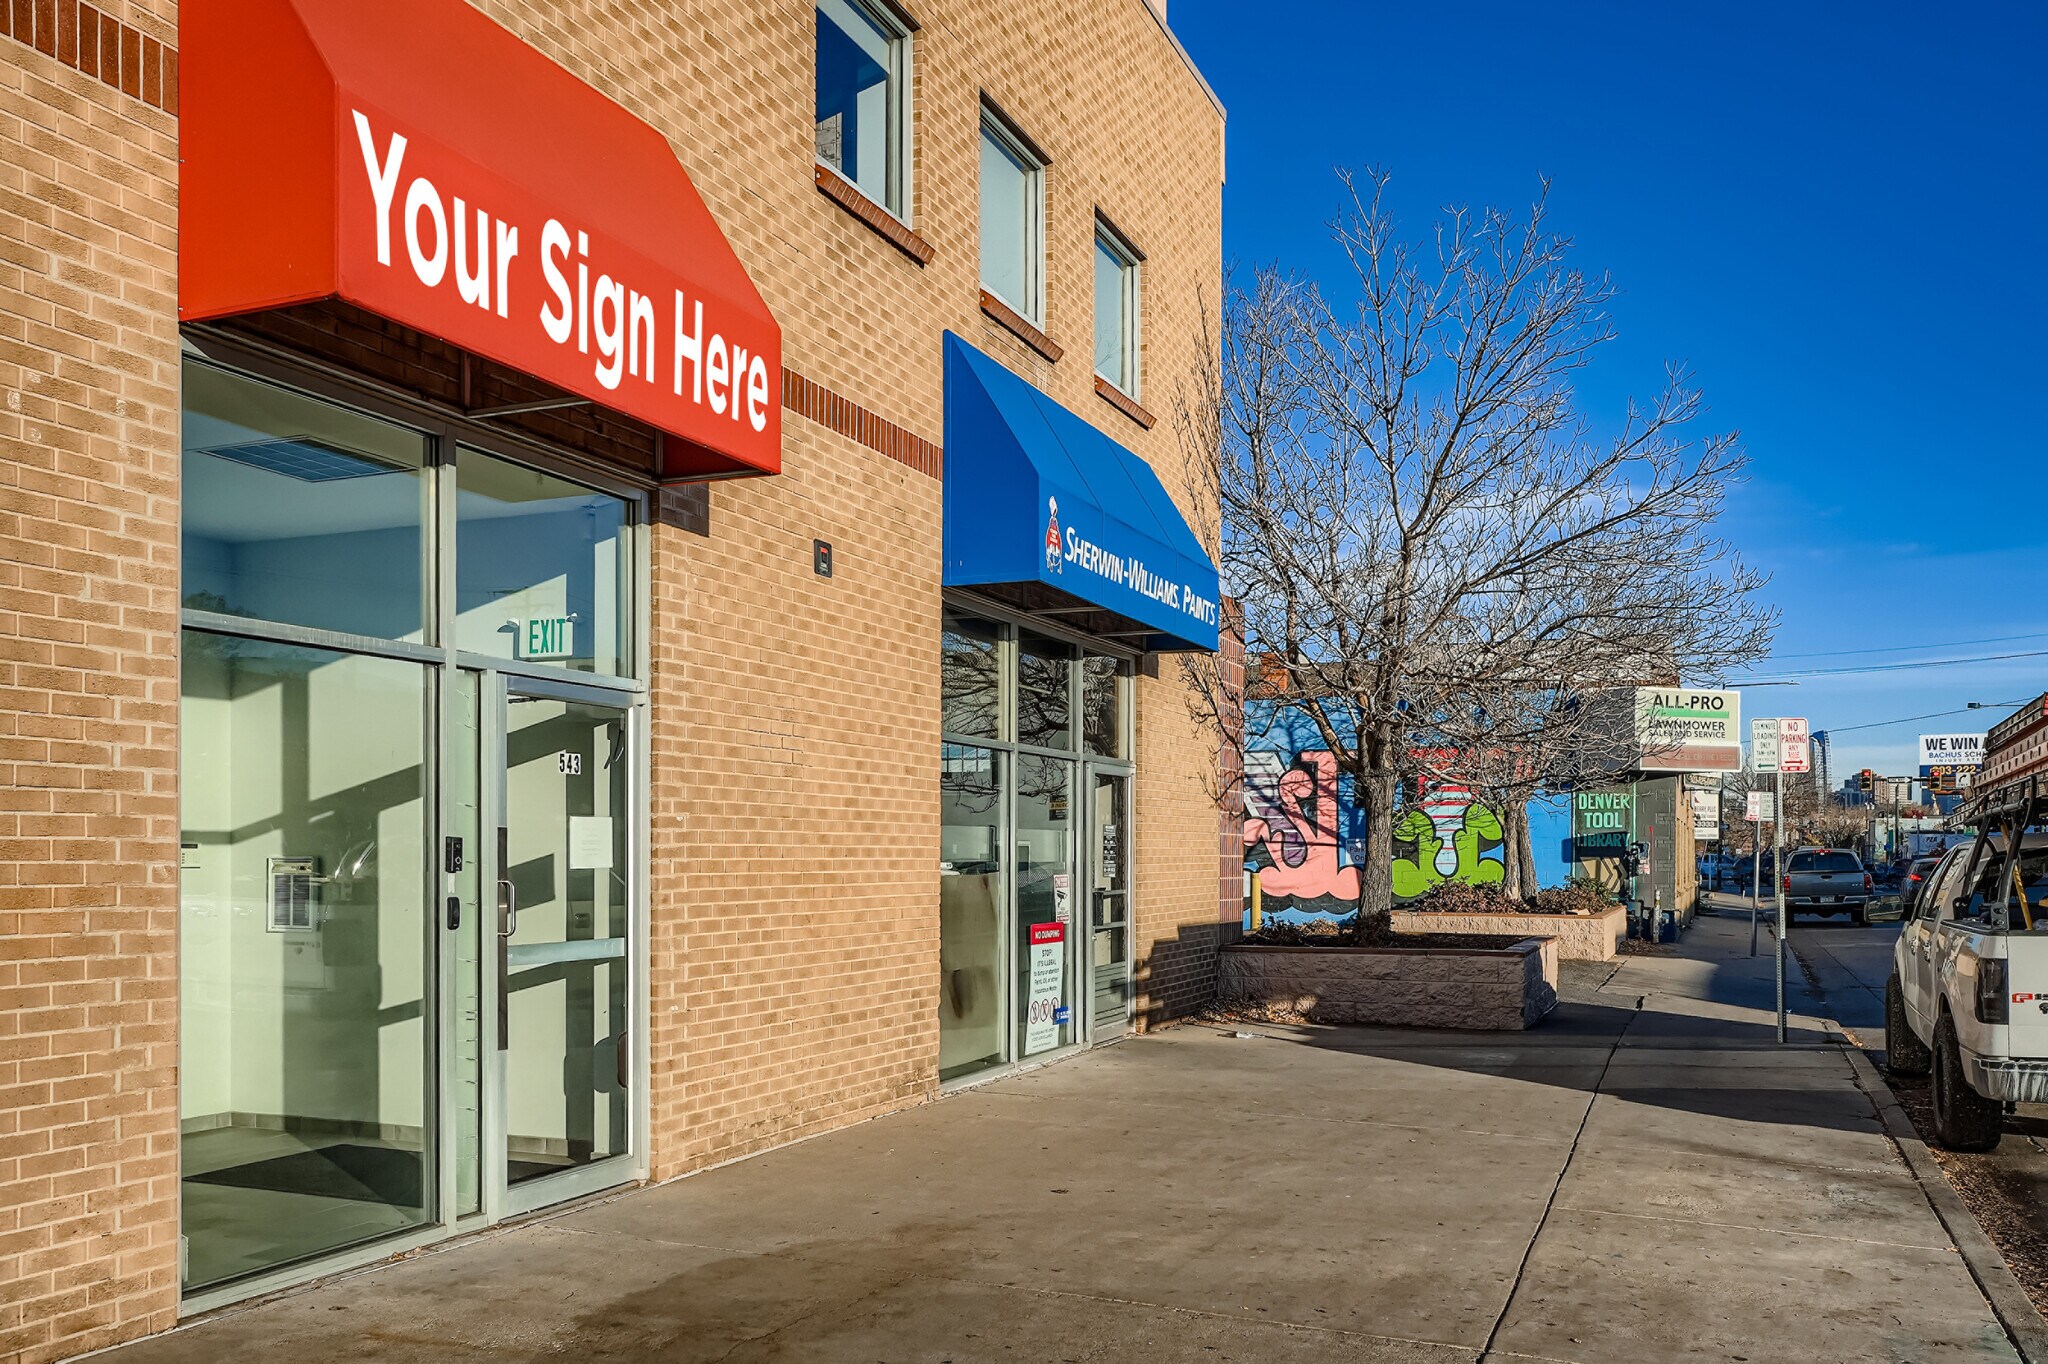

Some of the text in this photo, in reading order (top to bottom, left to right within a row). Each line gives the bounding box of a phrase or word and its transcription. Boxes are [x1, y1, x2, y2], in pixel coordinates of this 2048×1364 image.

[352, 108, 769, 432] Your Sign Here
[1182, 584, 1216, 626] PAINTS
[529, 618, 566, 654] EXIT
[1653, 694, 1724, 710] ALL-PRO
[1649, 720, 1726, 732] LAWNMOWER
[1787, 721, 1799, 732] NO
[1694, 731, 1726, 739] SERVICE
[1754, 732, 1777, 740] LOADING
[1781, 733, 1806, 744] PARKING
[1760, 741, 1771, 749] ONLY
[1925, 737, 1978, 751] WE WIN
[559, 753, 580, 773] 543
[1578, 793, 1631, 810] DENVER
[1584, 812, 1623, 828] TOOL
[1577, 833, 1631, 847] LIBRARY
[1034, 929, 1061, 940] NO DUMPING
